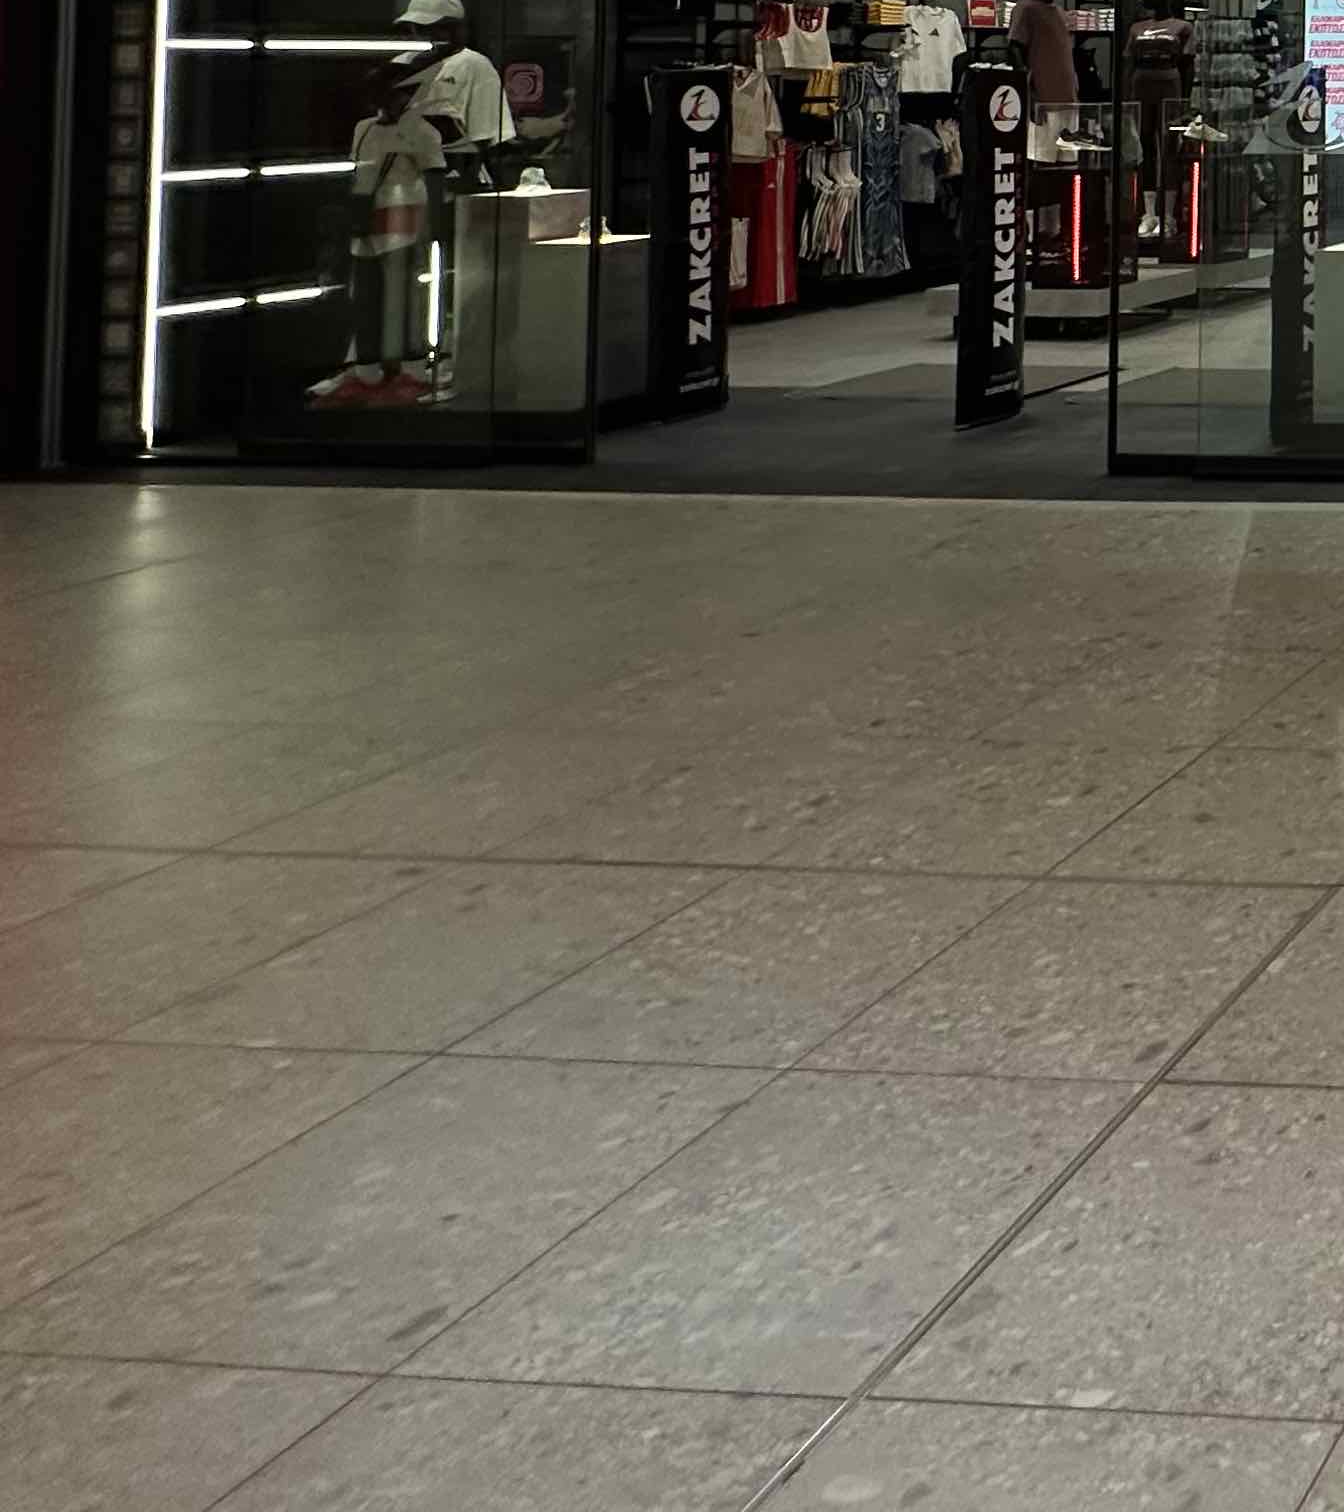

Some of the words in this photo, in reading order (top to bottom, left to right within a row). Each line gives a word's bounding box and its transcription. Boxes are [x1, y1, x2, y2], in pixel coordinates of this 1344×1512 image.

[876, 113, 886, 132] 3
[688, 146, 713, 345] ZAKCRET
[993, 147, 1017, 348] ZAKCRET
